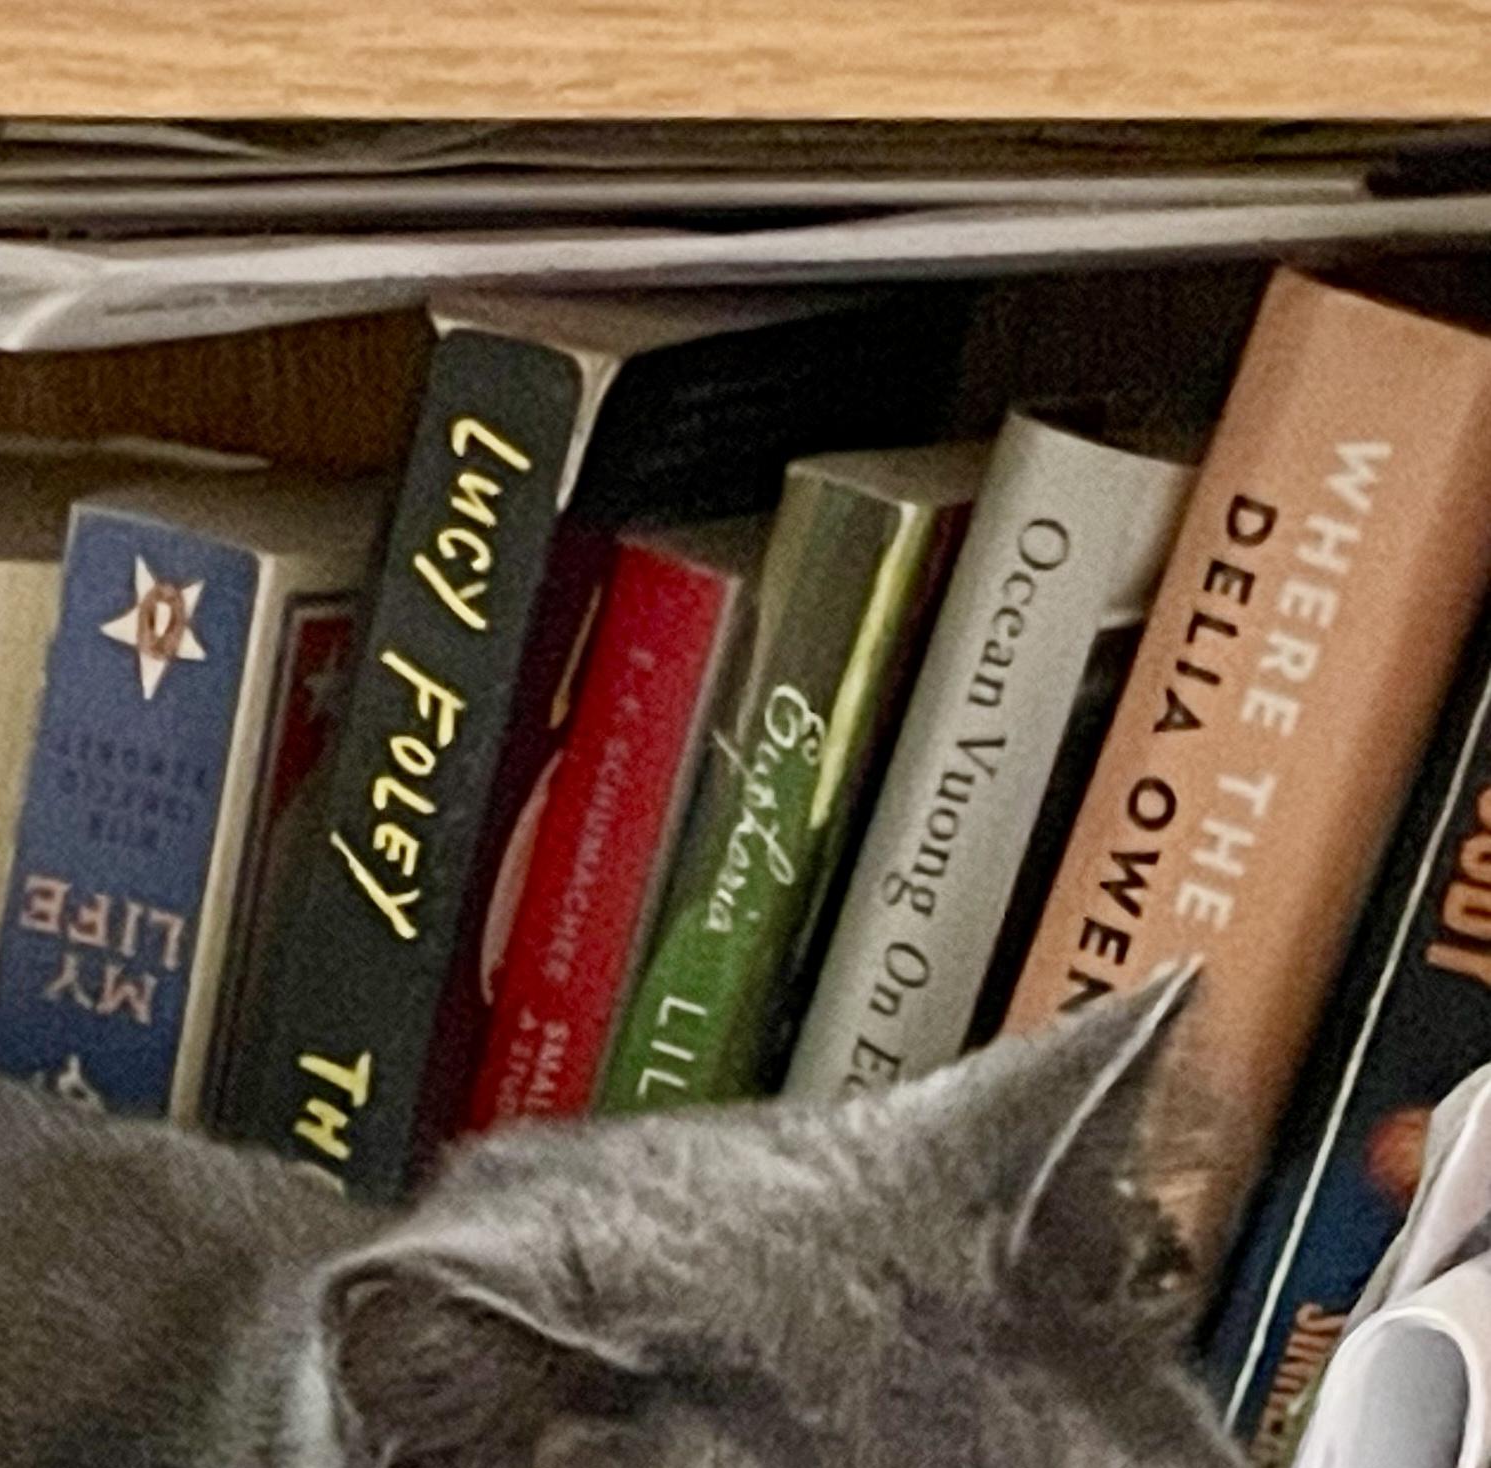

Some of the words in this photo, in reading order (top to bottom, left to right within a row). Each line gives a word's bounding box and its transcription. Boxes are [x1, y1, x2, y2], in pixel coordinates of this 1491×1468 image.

[968, 517, 1070, 708] Ocean
[1152, 494, 1278, 734] DELIA
[1241, 440, 1393, 737] WHERE
[330, 651, 466, 940] FOLEY
[882, 736, 1007, 918] Vuong
[1173, 771, 1278, 932] THE
[20, 874, 185, 972] LIFE
[45, 953, 159, 1025] MY
[869, 942, 930, 1017] On
[294, 1050, 371, 1163] TH
